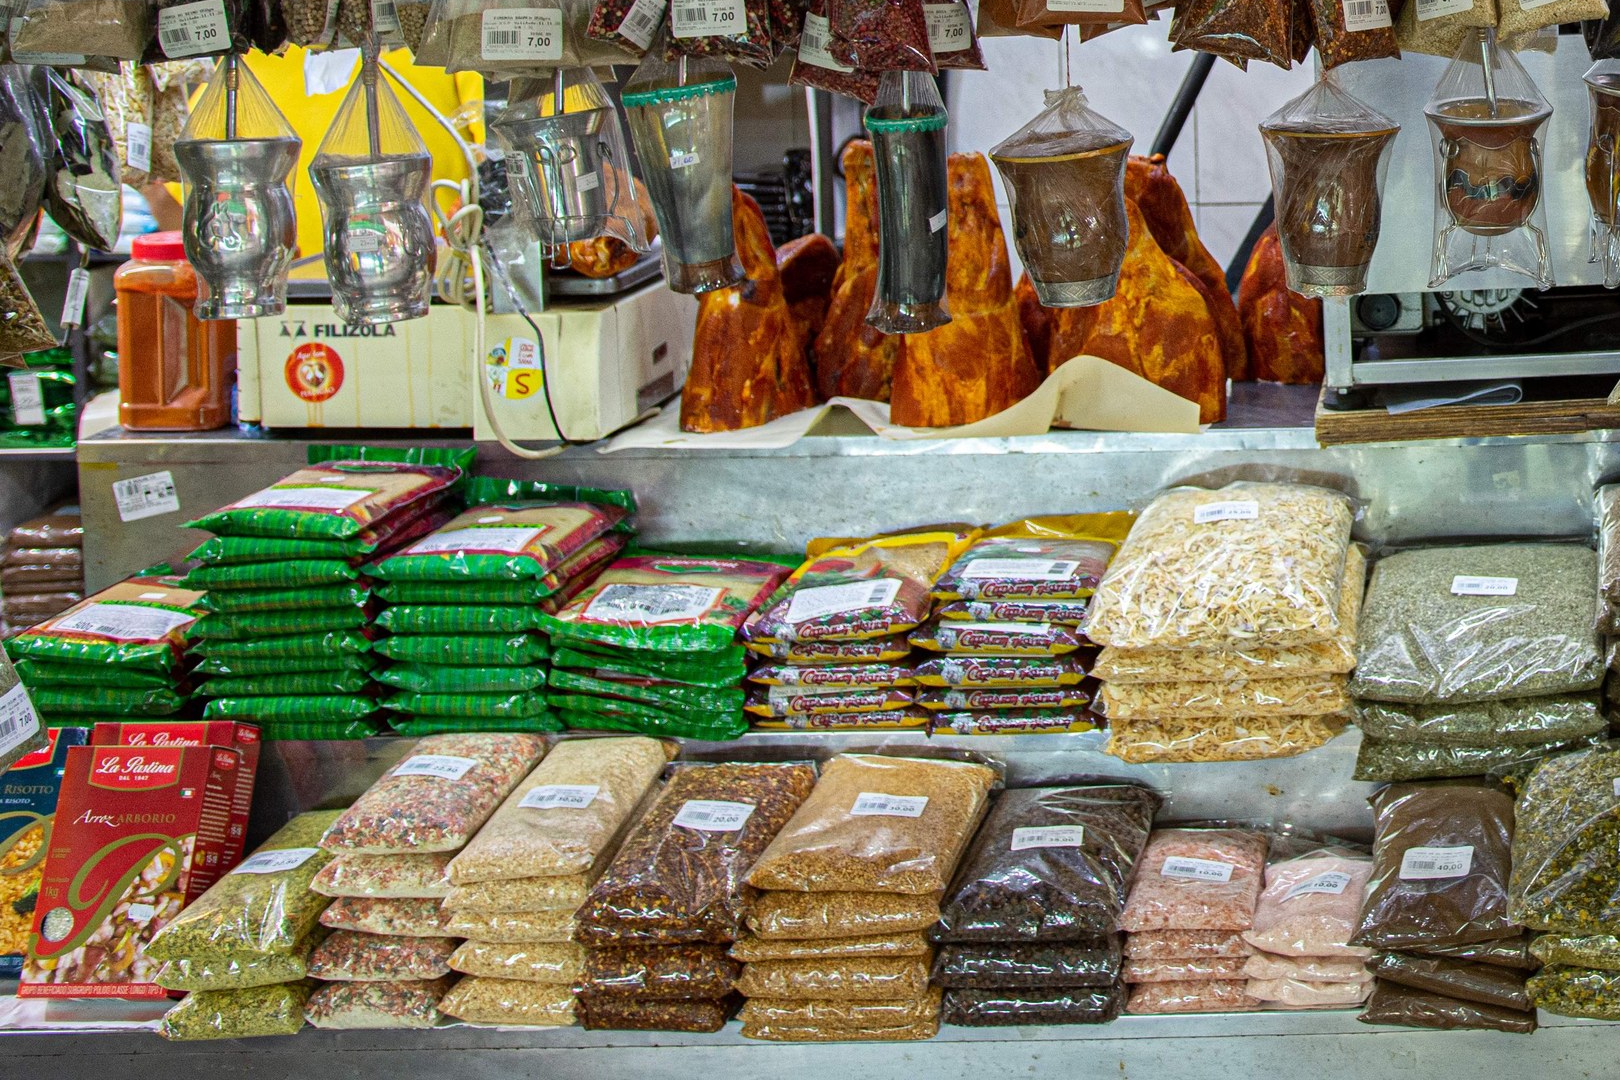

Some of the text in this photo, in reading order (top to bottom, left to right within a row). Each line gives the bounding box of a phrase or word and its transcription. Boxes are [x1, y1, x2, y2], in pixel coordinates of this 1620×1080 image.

[712, 11, 735, 23] 7,00
[195, 28, 216, 41] 7,00
[527, 36, 551, 47] 7,00
[314, 324, 395, 337] FILIZOLA
[516, 373, 530, 394] S
[96, 757, 174, 774] La Pastina
[4, 784, 54, 795] RISOTTO
[74, 808, 176, 826] Arroz ARBORIO
